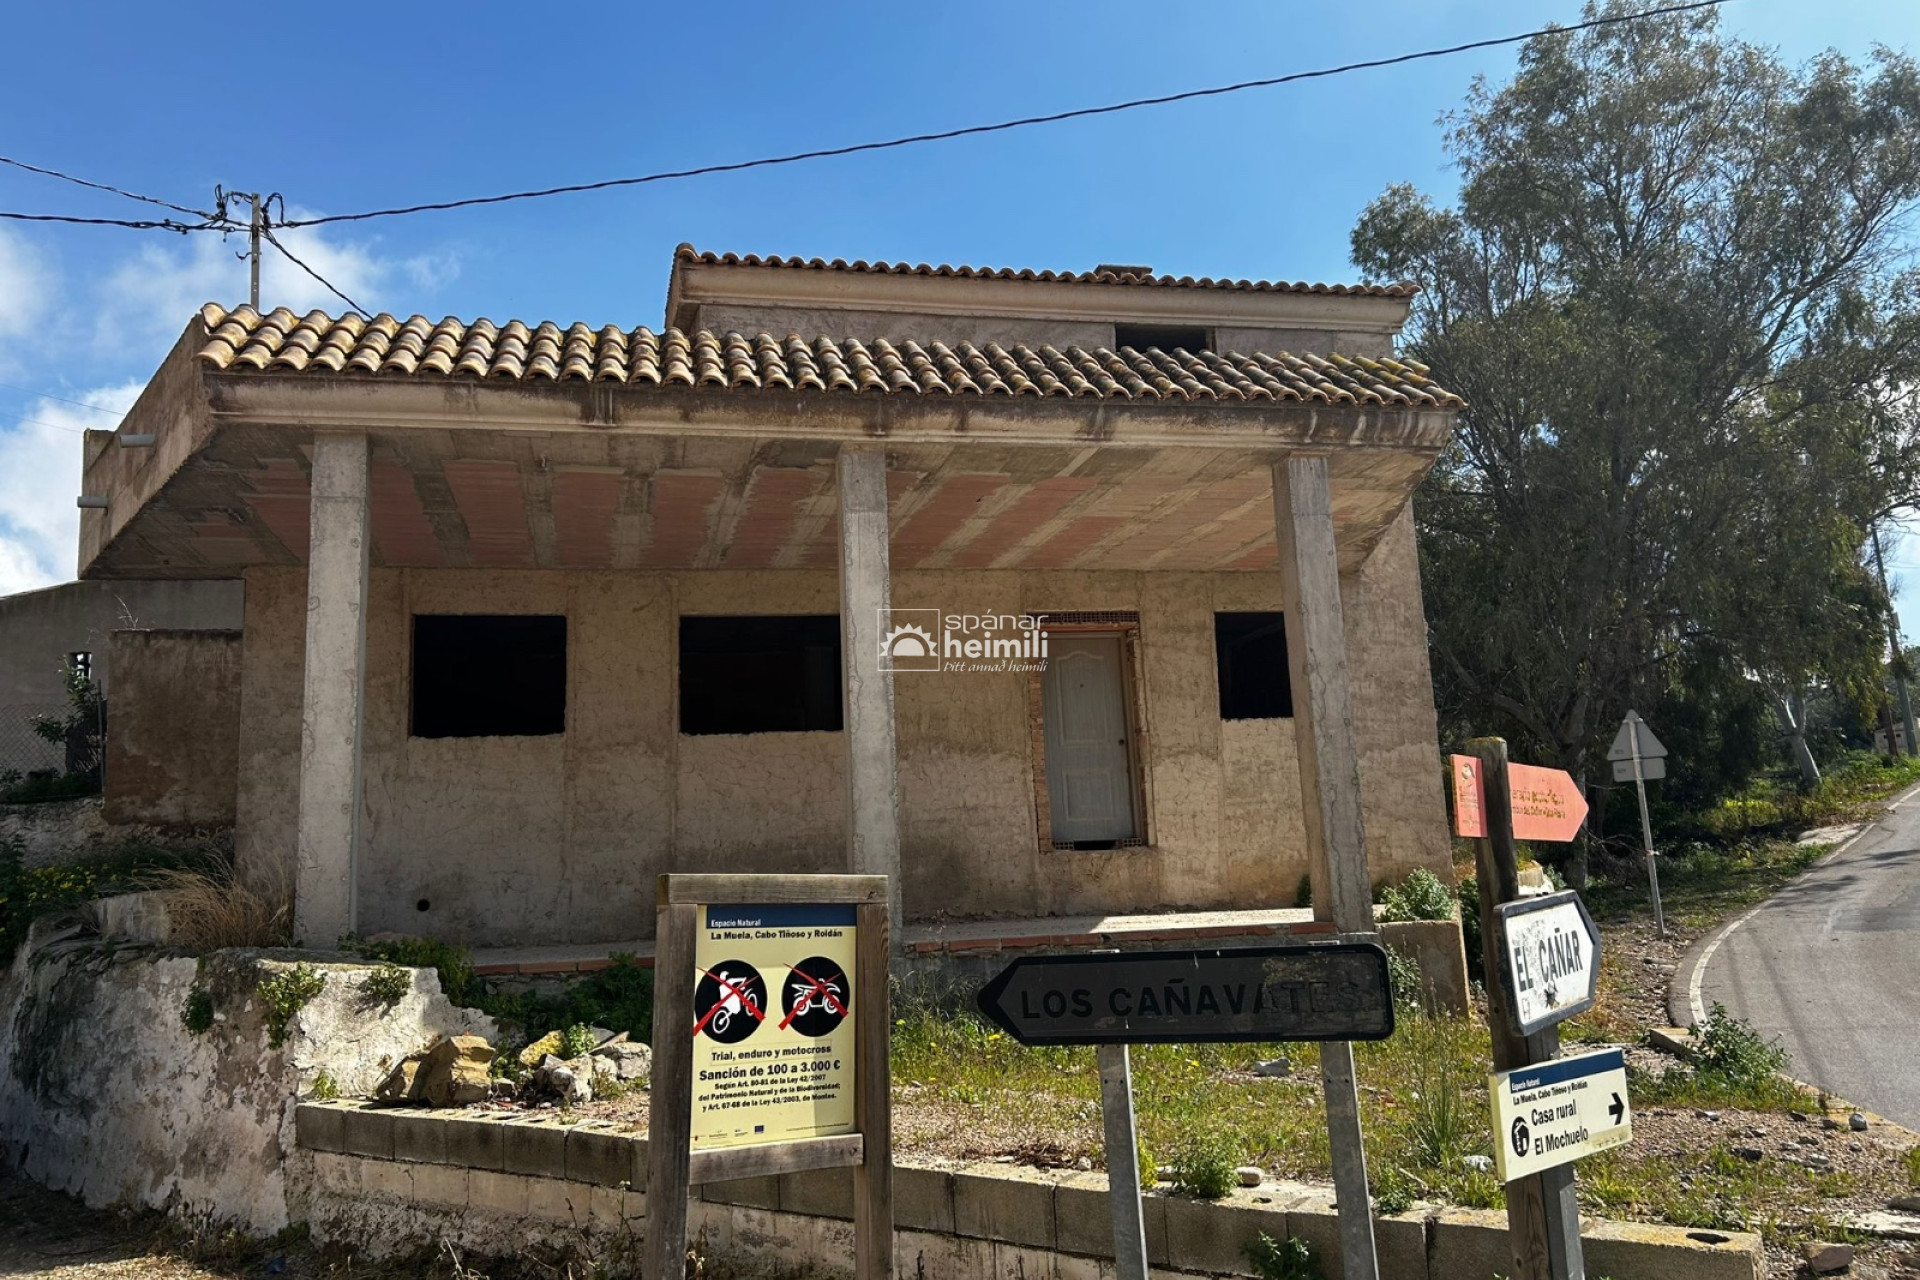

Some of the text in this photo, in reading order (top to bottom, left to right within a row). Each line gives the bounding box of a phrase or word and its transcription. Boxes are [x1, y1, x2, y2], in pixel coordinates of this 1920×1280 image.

[711, 918, 762, 928] Espacio Natural
[711, 928, 843, 940] La Muela, Cabo Tiñoso y Roldán
[1514, 927, 1583, 992] EL CAÑAR
[1021, 977, 1361, 1019] LOS CAÑAVATES
[711, 1045, 832, 1061] Trial, enduro y motocross
[699, 1059, 841, 1081] Sanción de 100 a 3.000 €
[714, 1082, 737, 1091] Según
[738, 1080, 750, 1088] Art.
[786, 1076, 798, 1085] Ley
[800, 1073, 826, 1083] 42/2007
[698, 1094, 710, 1102] del
[711, 1091, 748, 1101] Patrimonio
[749, 1088, 774, 1097] Natural
[789, 1085, 796, 1093] la
[702, 1105, 707, 1113] y
[708, 1103, 721, 1111] Art.
[759, 1098, 771, 1107] Ley
[802, 1094, 811, 1102] de
[1513, 1096, 1520, 1106] La
[1538, 1088, 1551, 1100] Cabo
[1567, 1084, 1572, 1095] y
[1531, 1099, 1577, 1127] Casa rural
[1535, 1126, 1589, 1156] El Mochuelo
